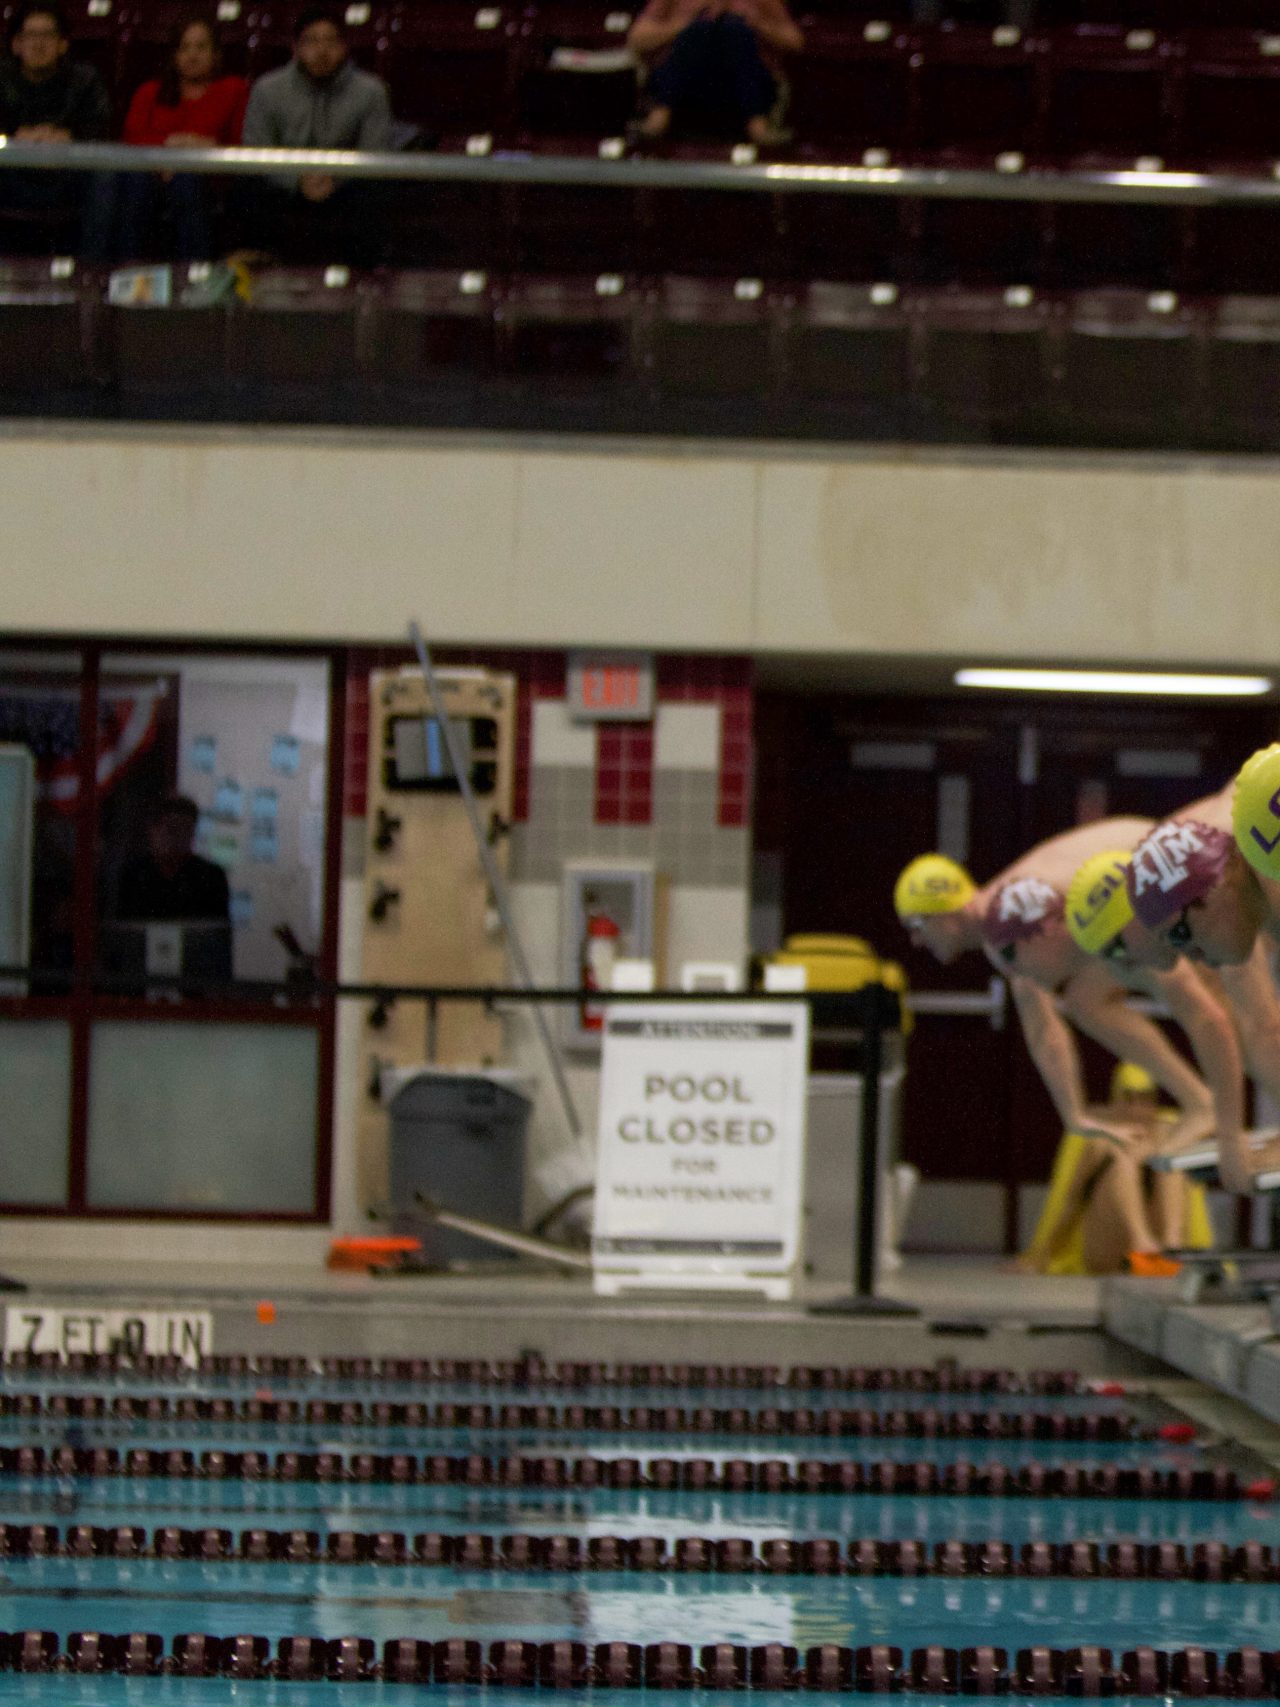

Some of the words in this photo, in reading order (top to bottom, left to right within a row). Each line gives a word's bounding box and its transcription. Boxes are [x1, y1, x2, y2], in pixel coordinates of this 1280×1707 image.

[583, 665, 640, 706] EXIT
[644, 1074, 752, 1104] POOL
[617, 1116, 776, 1146] CLOSED
[671, 1155, 717, 1175] FOR
[611, 1184, 773, 1202] MAINTENANCE
